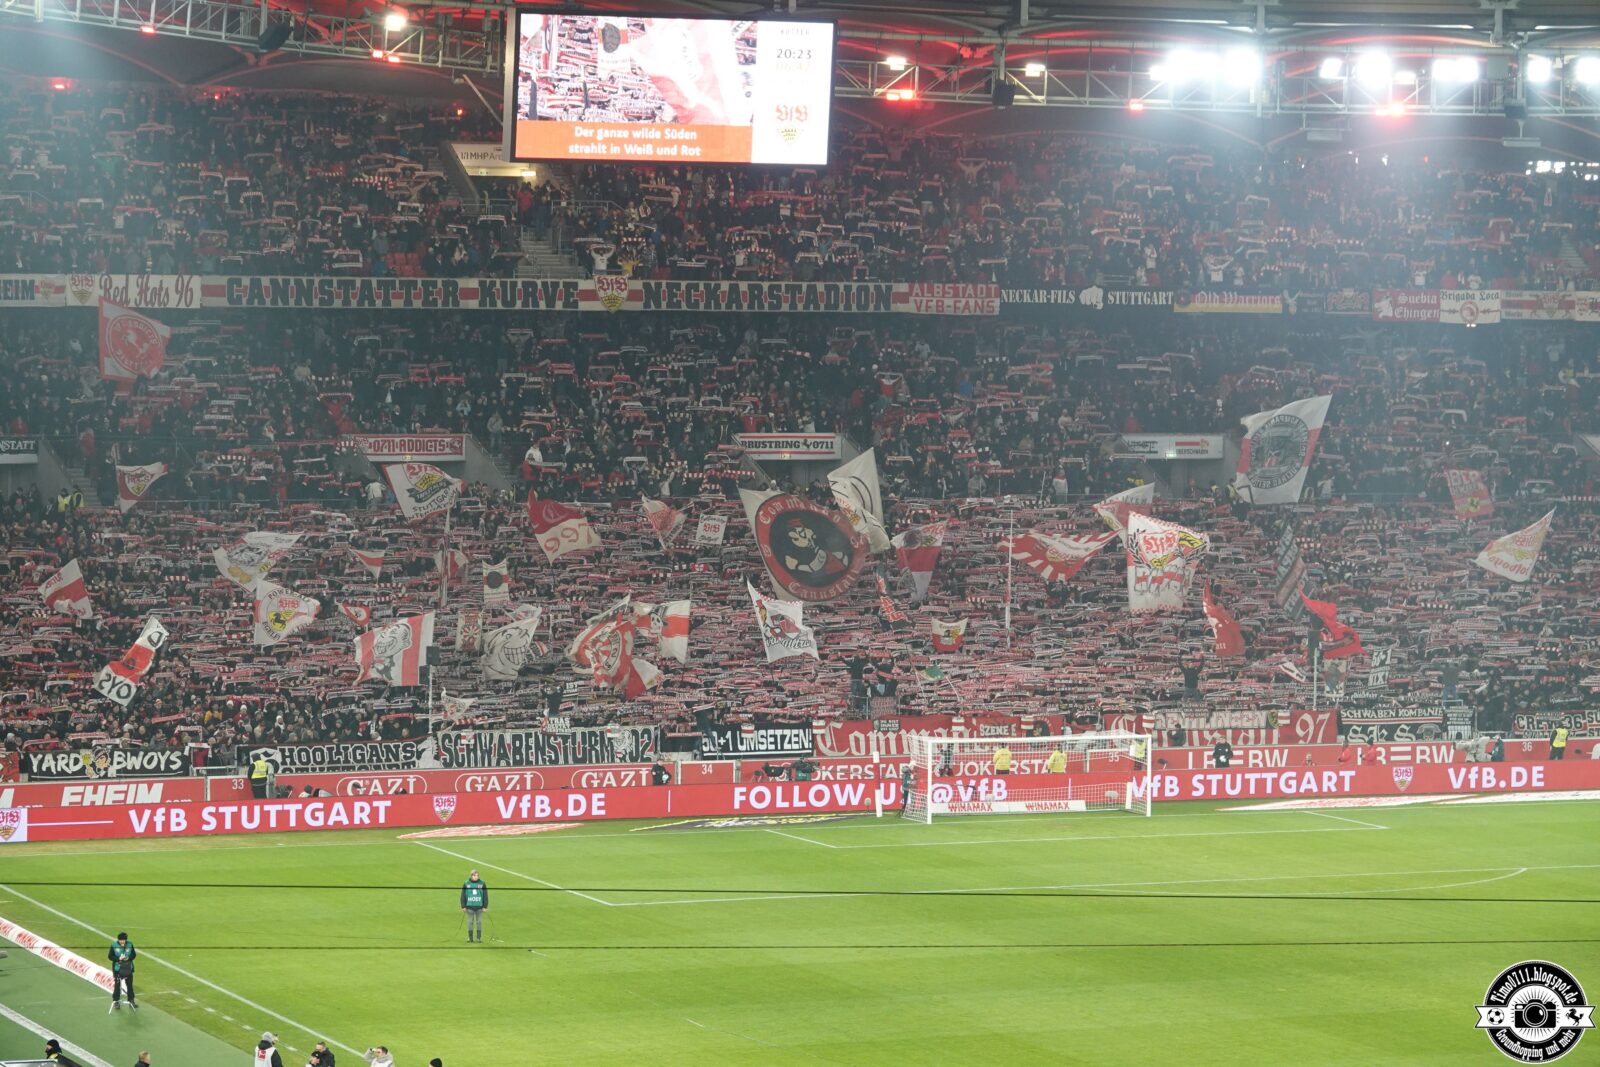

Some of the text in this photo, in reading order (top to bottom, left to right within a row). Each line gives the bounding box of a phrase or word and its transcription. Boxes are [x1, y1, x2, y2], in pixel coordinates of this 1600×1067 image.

[776, 48, 812, 60] 20:23
[574, 127, 697, 141] Der ganze wilde Süden
[568, 143, 702, 156] strahlt in Weiß und Rot
[101, 274, 130, 306] Red
[175, 274, 194, 307] 96
[226, 278, 580, 309] CANNSTATTER KURVE
[642, 281, 893, 312] NECKARSTADION
[912, 283, 999, 297] ALBSTADT
[1000, 289, 1174, 305] NECKAR-FILS STUTTGART
[914, 299, 997, 314] VFB-FANS
[399, 438, 446, 453] ADDICTS
[740, 440, 834, 450] BRUSTRING 0711
[1340, 709, 1396, 719] SCHWABEN
[1398, 708, 1444, 718] KOMPANIE
[979, 723, 1009, 736] SZENE
[1294, 712, 1331, 745] 97
[1563, 714, 1583, 730] 36
[737, 728, 812, 751] UMSETZEN!
[1522, 741, 1533, 752] 36
[279, 742, 417, 767] HOOLIGANS
[440, 730, 614, 768] SCHWABENSTURM
[29, 750, 182, 775] YARD BWOYS
[701, 763, 713, 776] 34
[231, 778, 244, 790] 33
[1131, 770, 1356, 798] VfB STUTTGART
[1447, 765, 1545, 789] VfB.DE
[733, 783, 866, 810] FOLLOW
[496, 792, 607, 819] VfB.DE
[948, 801, 993, 812] WINAMAX
[1025, 799, 1071, 811] WINAMAX
[128, 800, 392, 833] VfB STUTTGART
